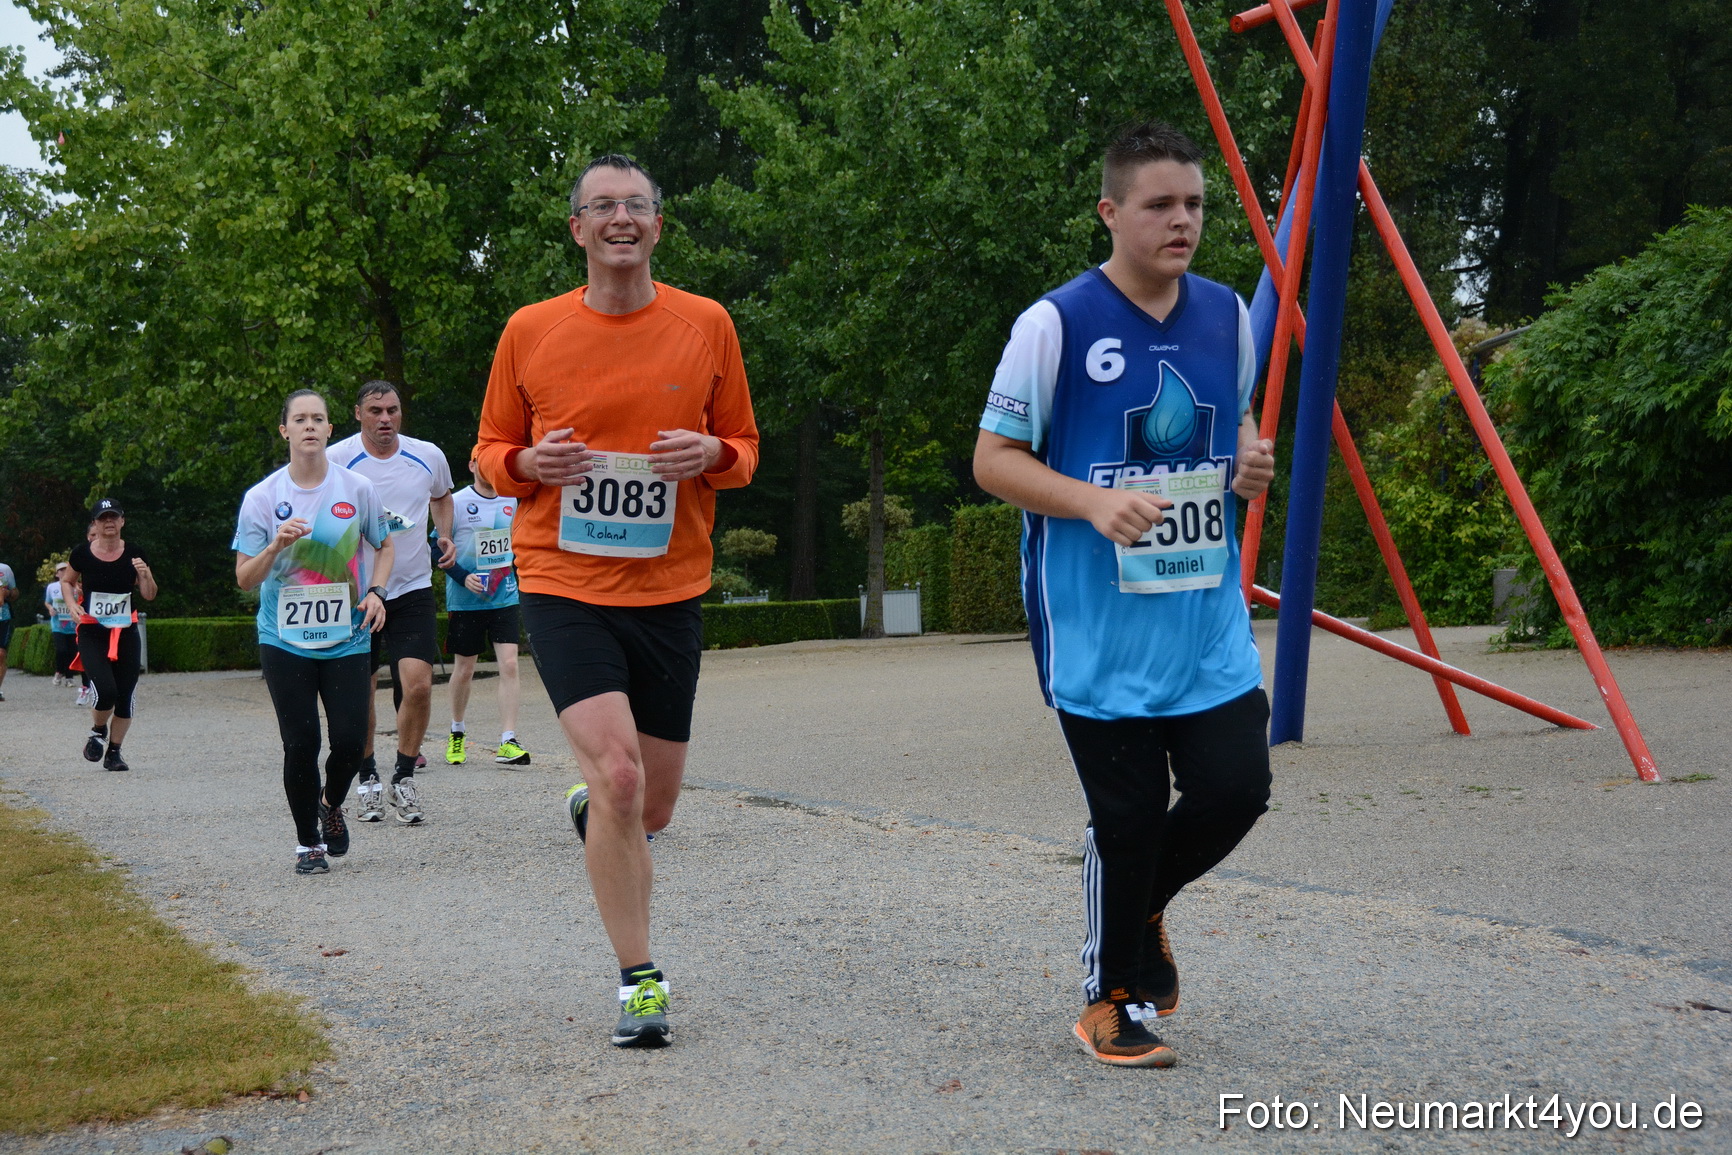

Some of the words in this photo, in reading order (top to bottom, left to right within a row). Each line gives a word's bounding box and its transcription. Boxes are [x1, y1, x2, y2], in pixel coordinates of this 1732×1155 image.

[1086, 338, 1125, 382] 6
[1168, 474, 1219, 491] BOCK
[573, 476, 666, 518] 3083
[585, 522, 626, 540] Roland
[1130, 499, 1223, 548] 508
[481, 537, 509, 555] 2612
[1155, 555, 1204, 576] Daniel
[309, 586, 343, 595] BOCK
[286, 599, 343, 625] 2707
[303, 630, 328, 640] Carra
